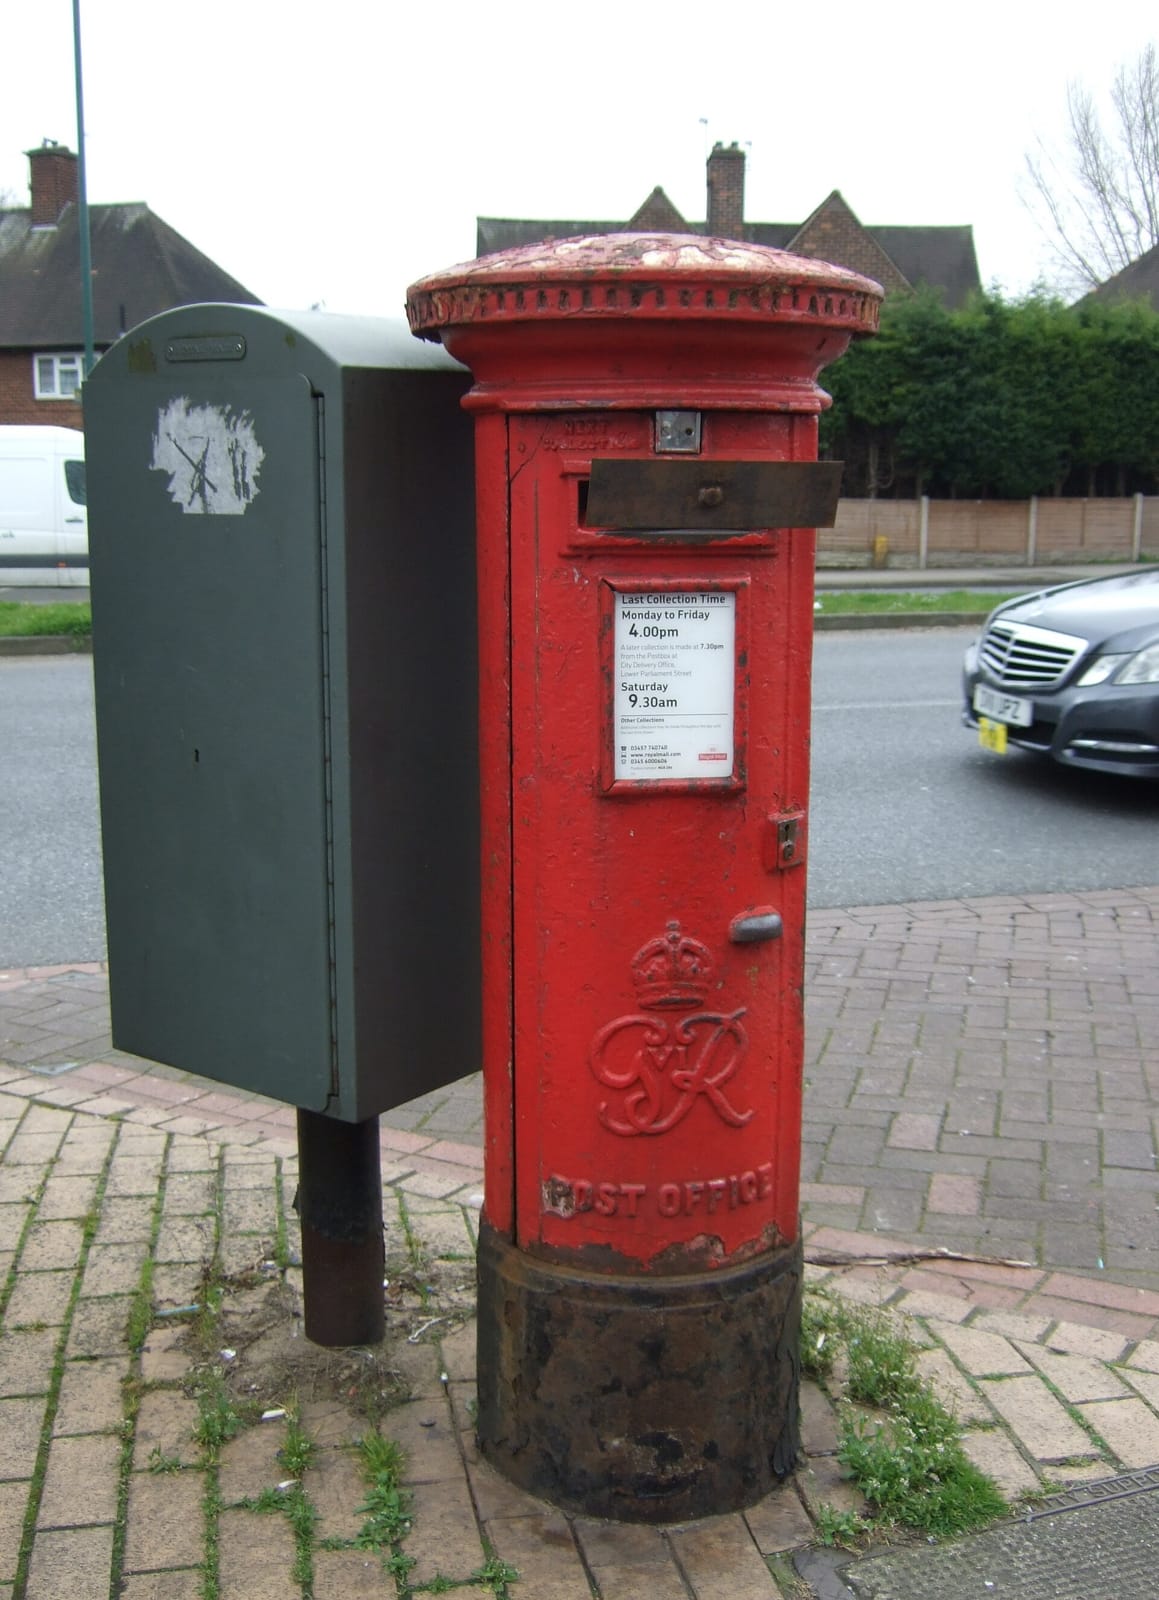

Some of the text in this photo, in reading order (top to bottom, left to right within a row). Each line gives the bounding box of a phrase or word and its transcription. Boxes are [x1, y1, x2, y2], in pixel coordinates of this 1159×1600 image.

[564, 420, 609, 436] NEXT
[622, 594, 726, 604] Last Collection Time
[622, 610, 710, 621] Monday to Friday
[629, 623, 679, 640] 4.00pm
[621, 682, 668, 693] Saturday
[628, 693, 678, 708] 9.30am
[549, 1162, 773, 1219] POST OFFICE
